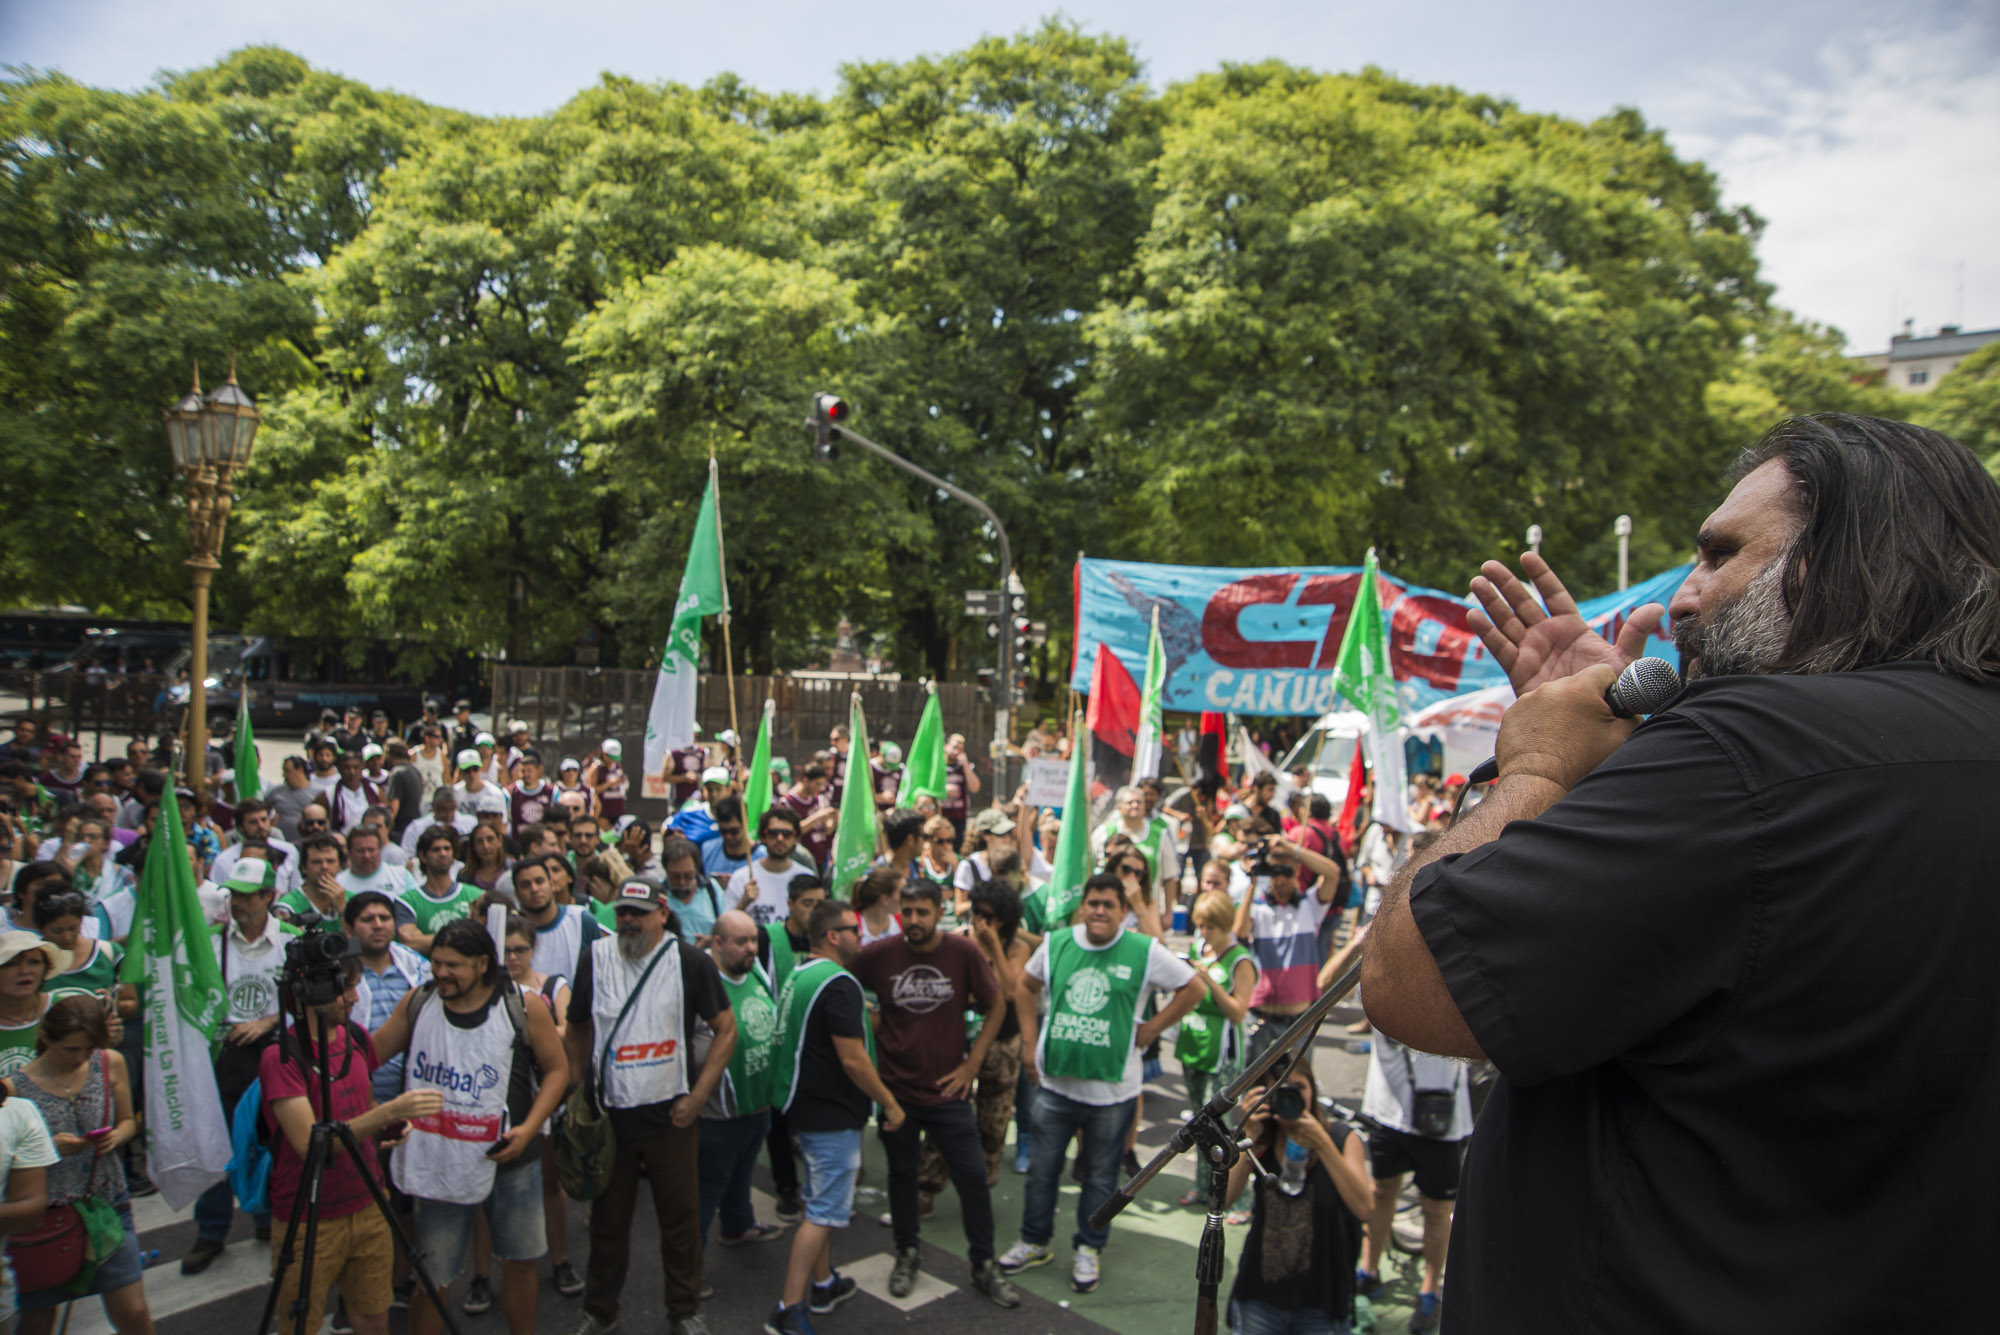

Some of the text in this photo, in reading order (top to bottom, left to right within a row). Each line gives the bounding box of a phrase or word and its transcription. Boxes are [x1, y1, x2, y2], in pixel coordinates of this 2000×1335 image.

[153, 988, 168, 1045] Liberar
[1054, 1012, 1110, 1034] ENACOM
[1065, 1027, 1111, 1048] AFSCA
[159, 1050, 173, 1070] La
[616, 1039, 676, 1062] CTA
[413, 1051, 473, 1092] Suteba
[163, 1073, 184, 1130] Nación
